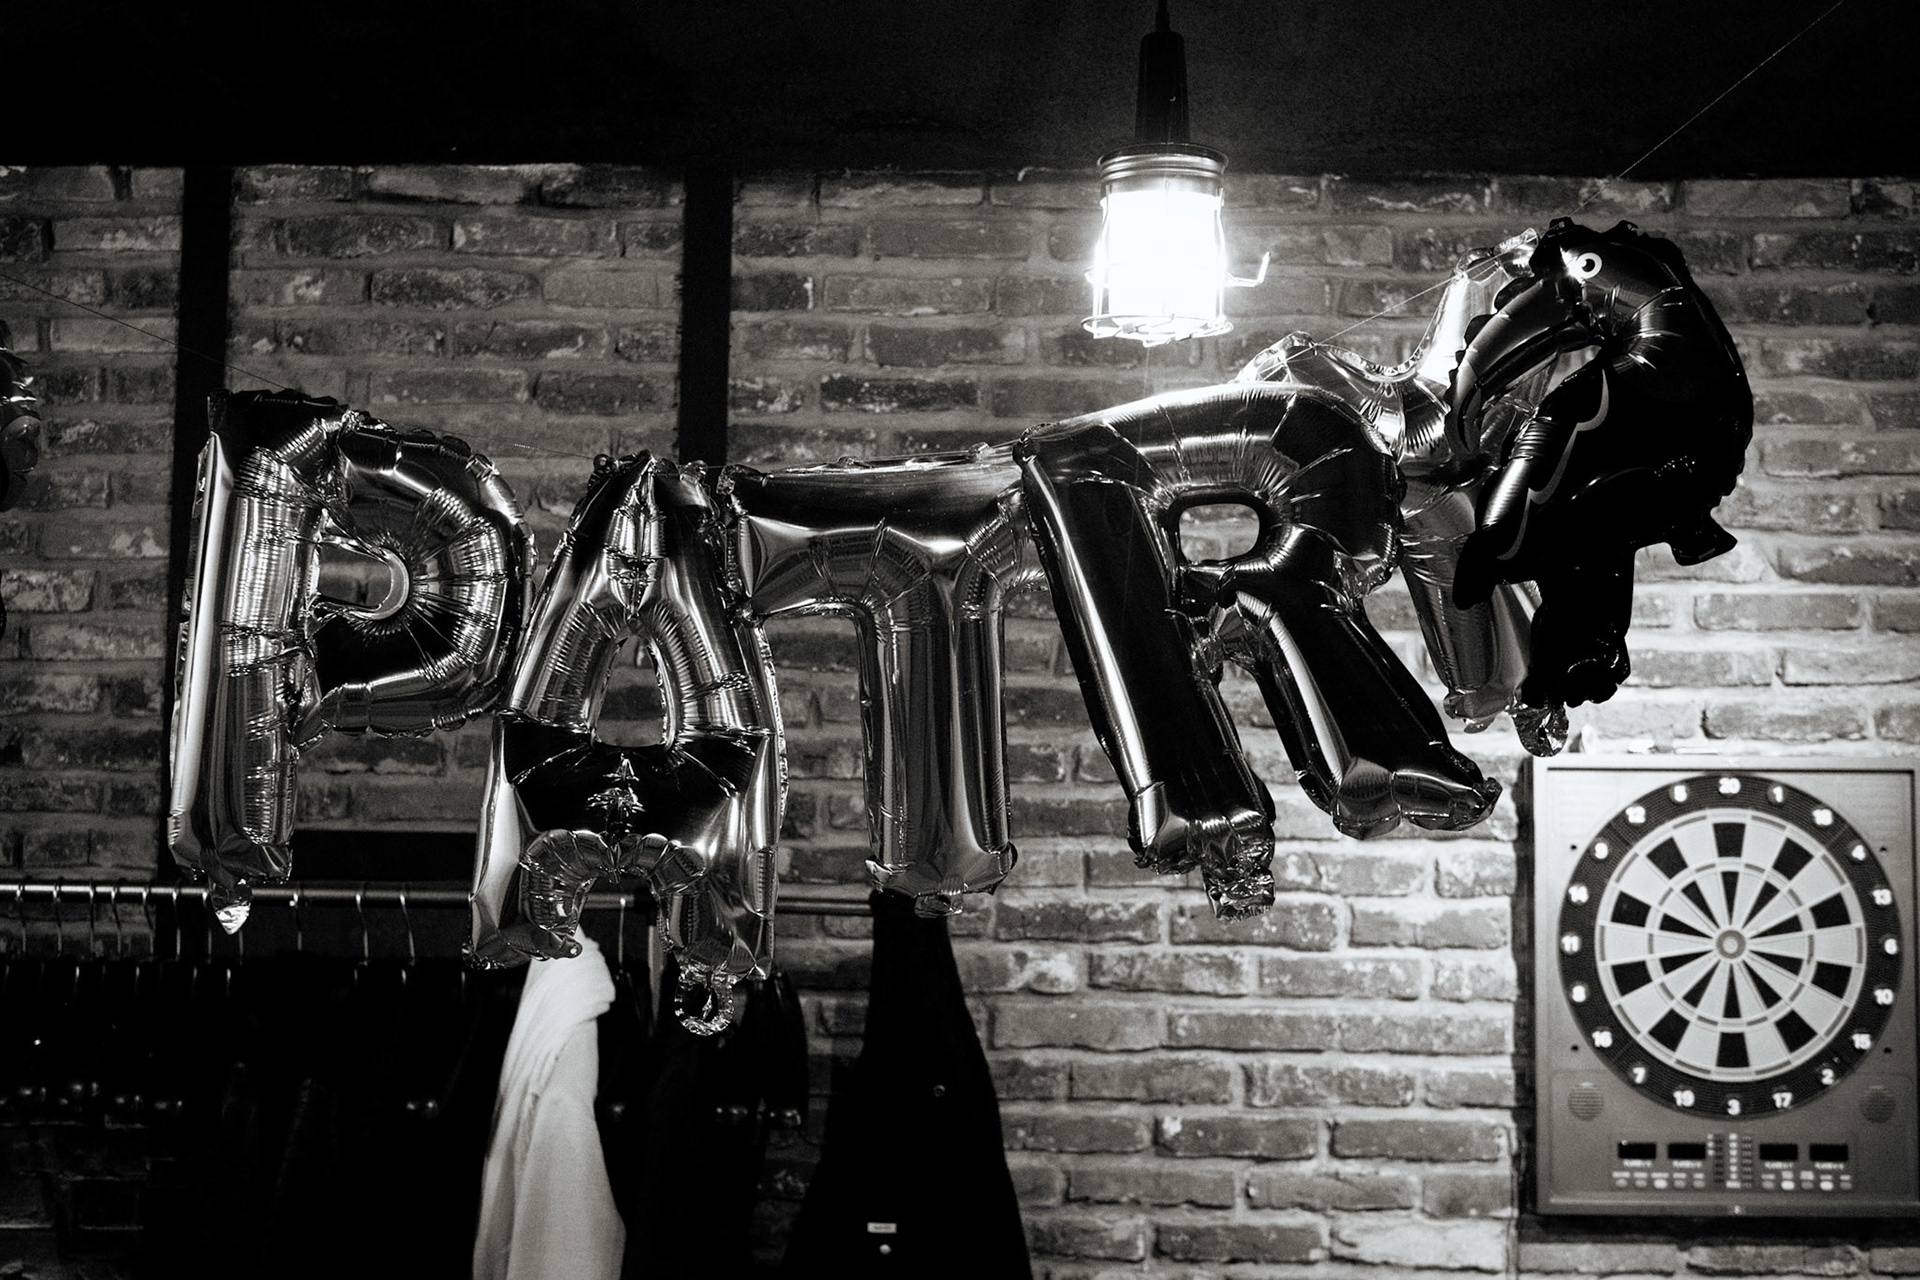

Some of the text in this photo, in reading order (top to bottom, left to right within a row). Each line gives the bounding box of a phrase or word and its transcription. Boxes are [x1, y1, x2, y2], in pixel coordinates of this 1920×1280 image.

[1719, 778, 1740, 793] 20
[1773, 787, 1783, 802] 1
[1626, 806, 1645, 823] 12
[1852, 845, 1865, 860] 4
[1873, 890, 1891, 904] 13
[1562, 936, 1579, 951] 11
[1885, 939, 1896, 954] 6
[1875, 989, 1893, 1004] 10
[1593, 1031, 1612, 1047] 16
[1853, 1034, 1870, 1048] 15
[1634, 1068, 1645, 1083] 7
[1823, 1070, 1833, 1083] 2
[1674, 1091, 1694, 1106] 19
[1774, 1093, 1791, 1107] 17
[1729, 1100, 1739, 1114] 3
